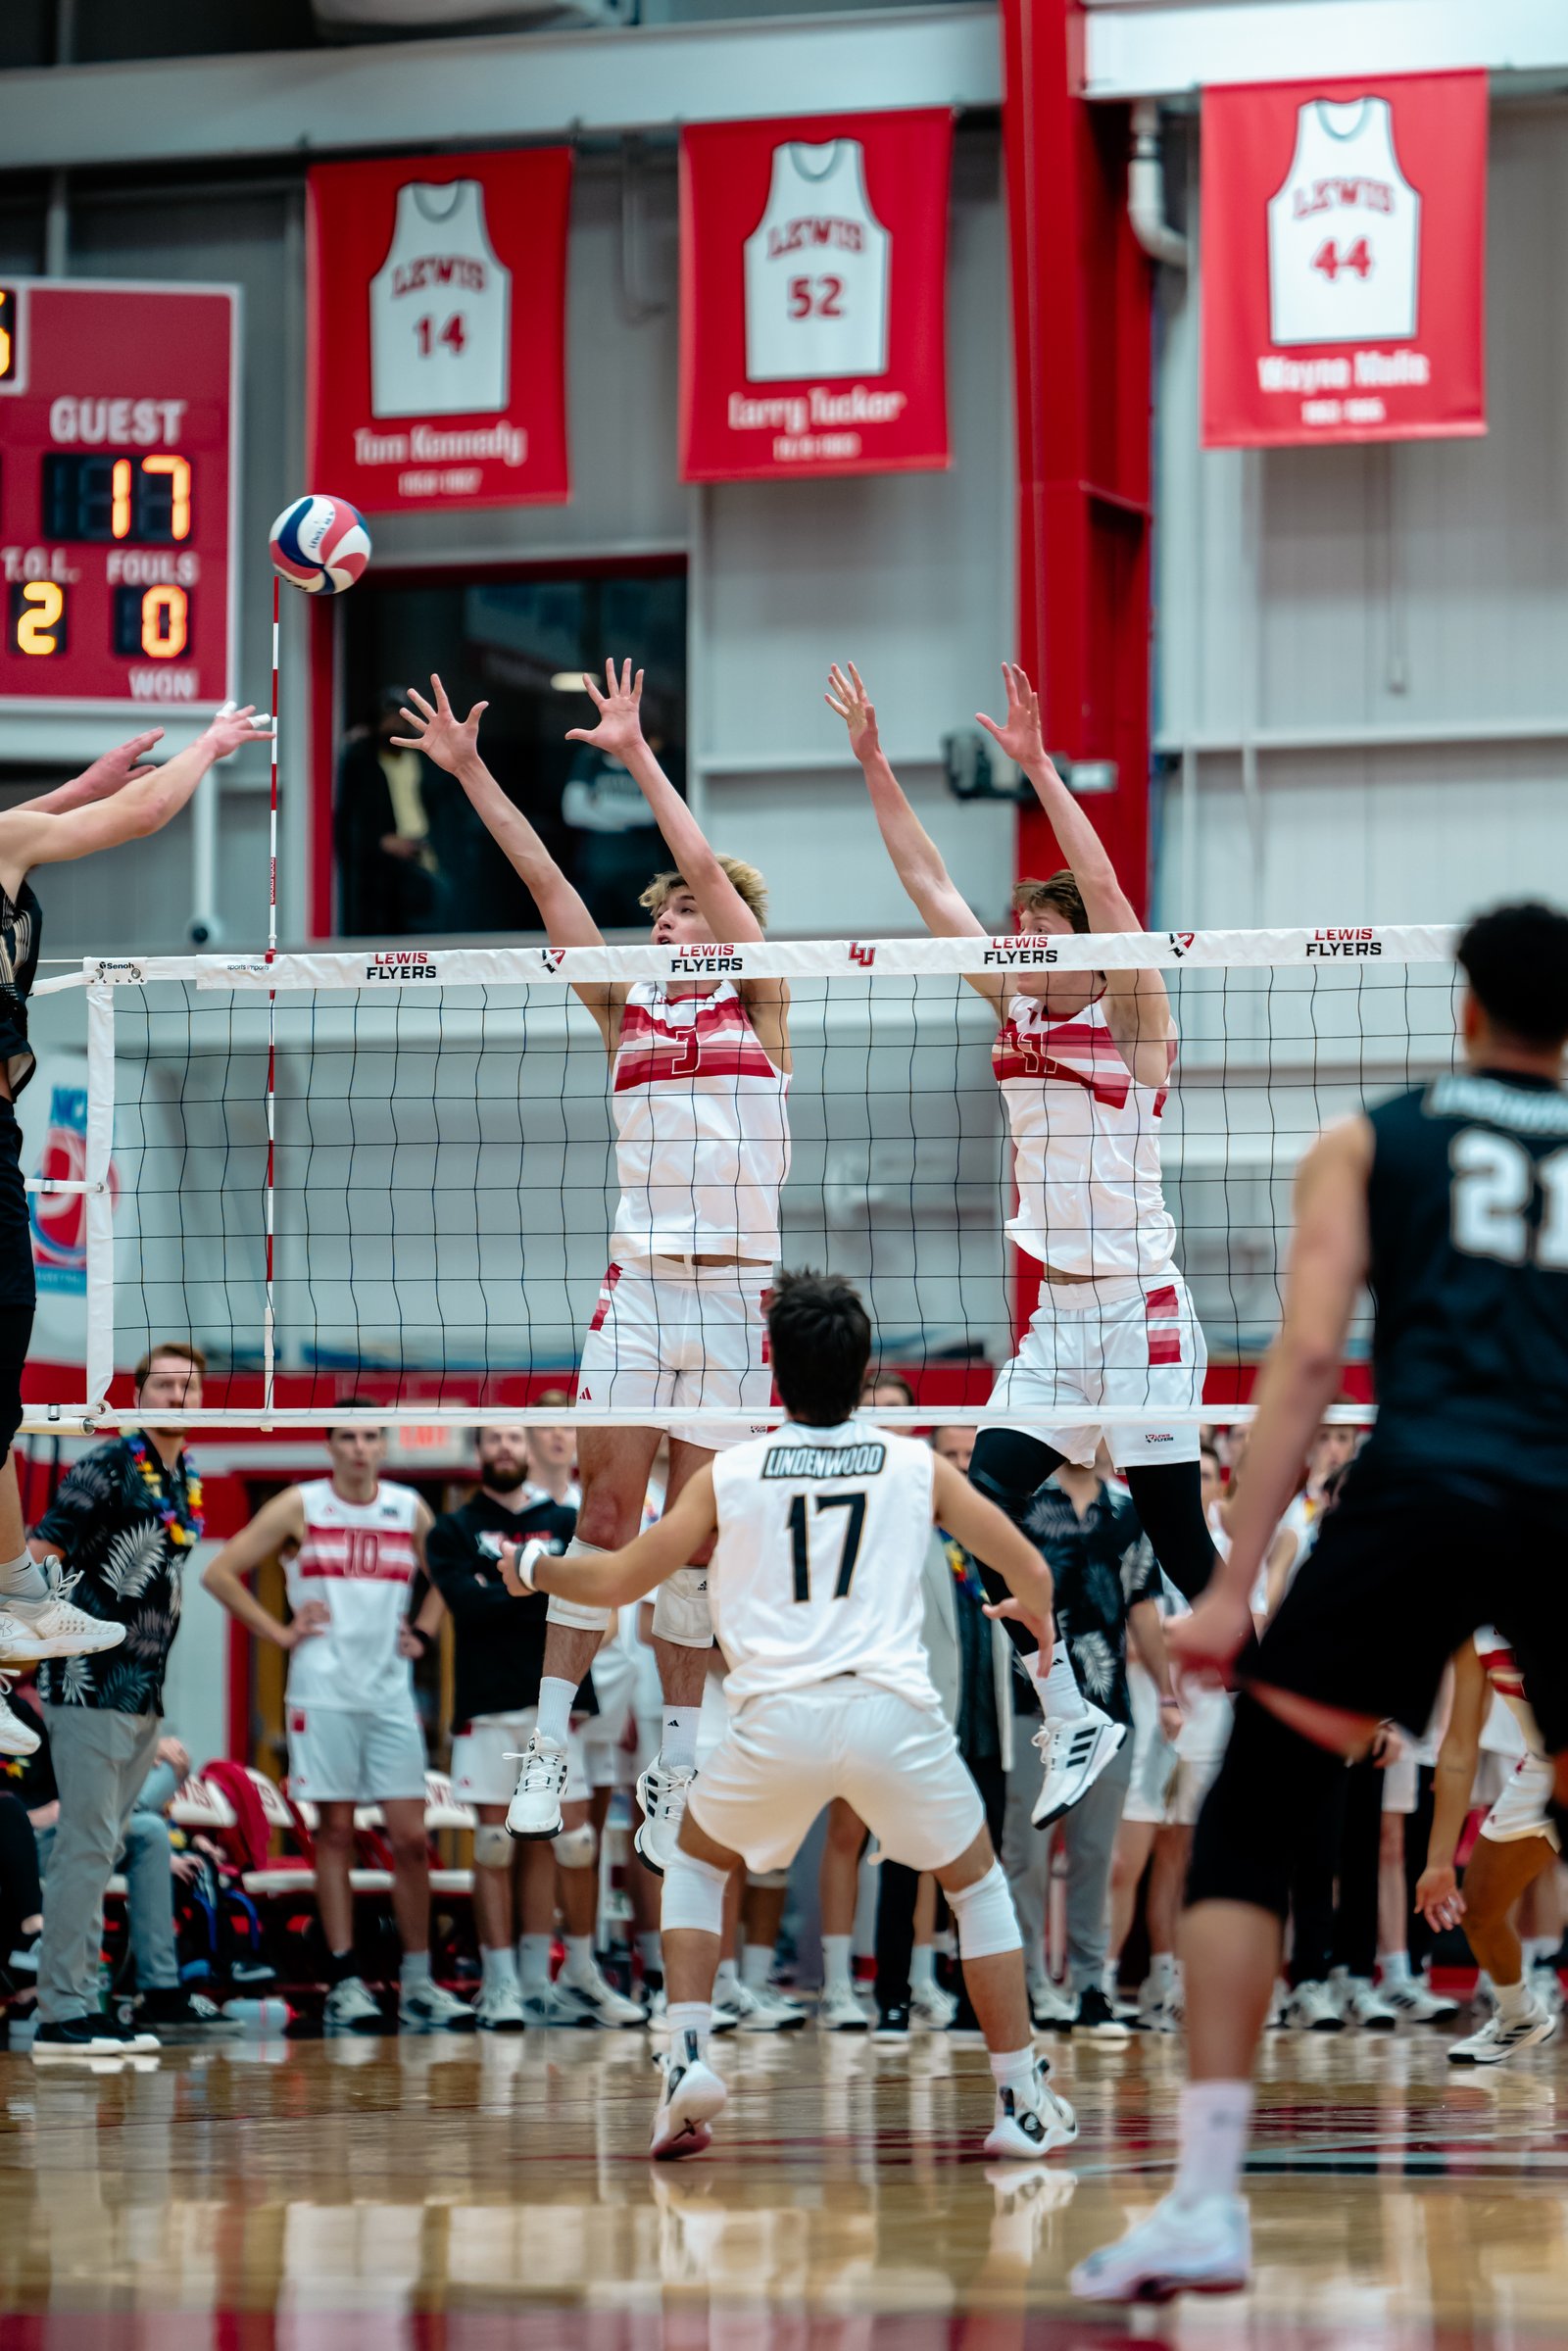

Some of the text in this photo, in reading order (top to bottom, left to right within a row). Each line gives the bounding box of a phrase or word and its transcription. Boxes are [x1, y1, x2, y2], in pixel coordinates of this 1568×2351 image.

[1293, 175, 1396, 221] LEWIS
[767, 217, 864, 261] LEWIS
[1310, 235, 1372, 283] 44
[393, 257, 487, 300] LEWIS
[788, 274, 844, 321] 52
[415, 311, 466, 358] 14
[50, 395, 187, 446] GUEST
[808, 385, 906, 425] Tucker
[410, 419, 528, 467] Kennedy
[112, 454, 191, 541] 17
[106, 549, 199, 587] FOULS
[18, 581, 64, 655] 2
[141, 585, 188, 659] 0
[128, 665, 199, 704] WON
[679, 945, 734, 956] LEWIS
[848, 941, 876, 967] LU
[992, 937, 1049, 950] LEWIS
[1305, 942, 1383, 956] FLYERS
[1314, 928, 1373, 941] LEWIS
[366, 965, 437, 979] FLYERS
[374, 953, 428, 964] LEWIS
[670, 957, 744, 972] FLYERS
[983, 950, 1058, 964] FLYERS
[1449, 1126, 1568, 1272] 21
[761, 1444, 886, 1480] LINDENWOOD
[344, 1528, 380, 1579] 10
[786, 1491, 868, 1603] 17
